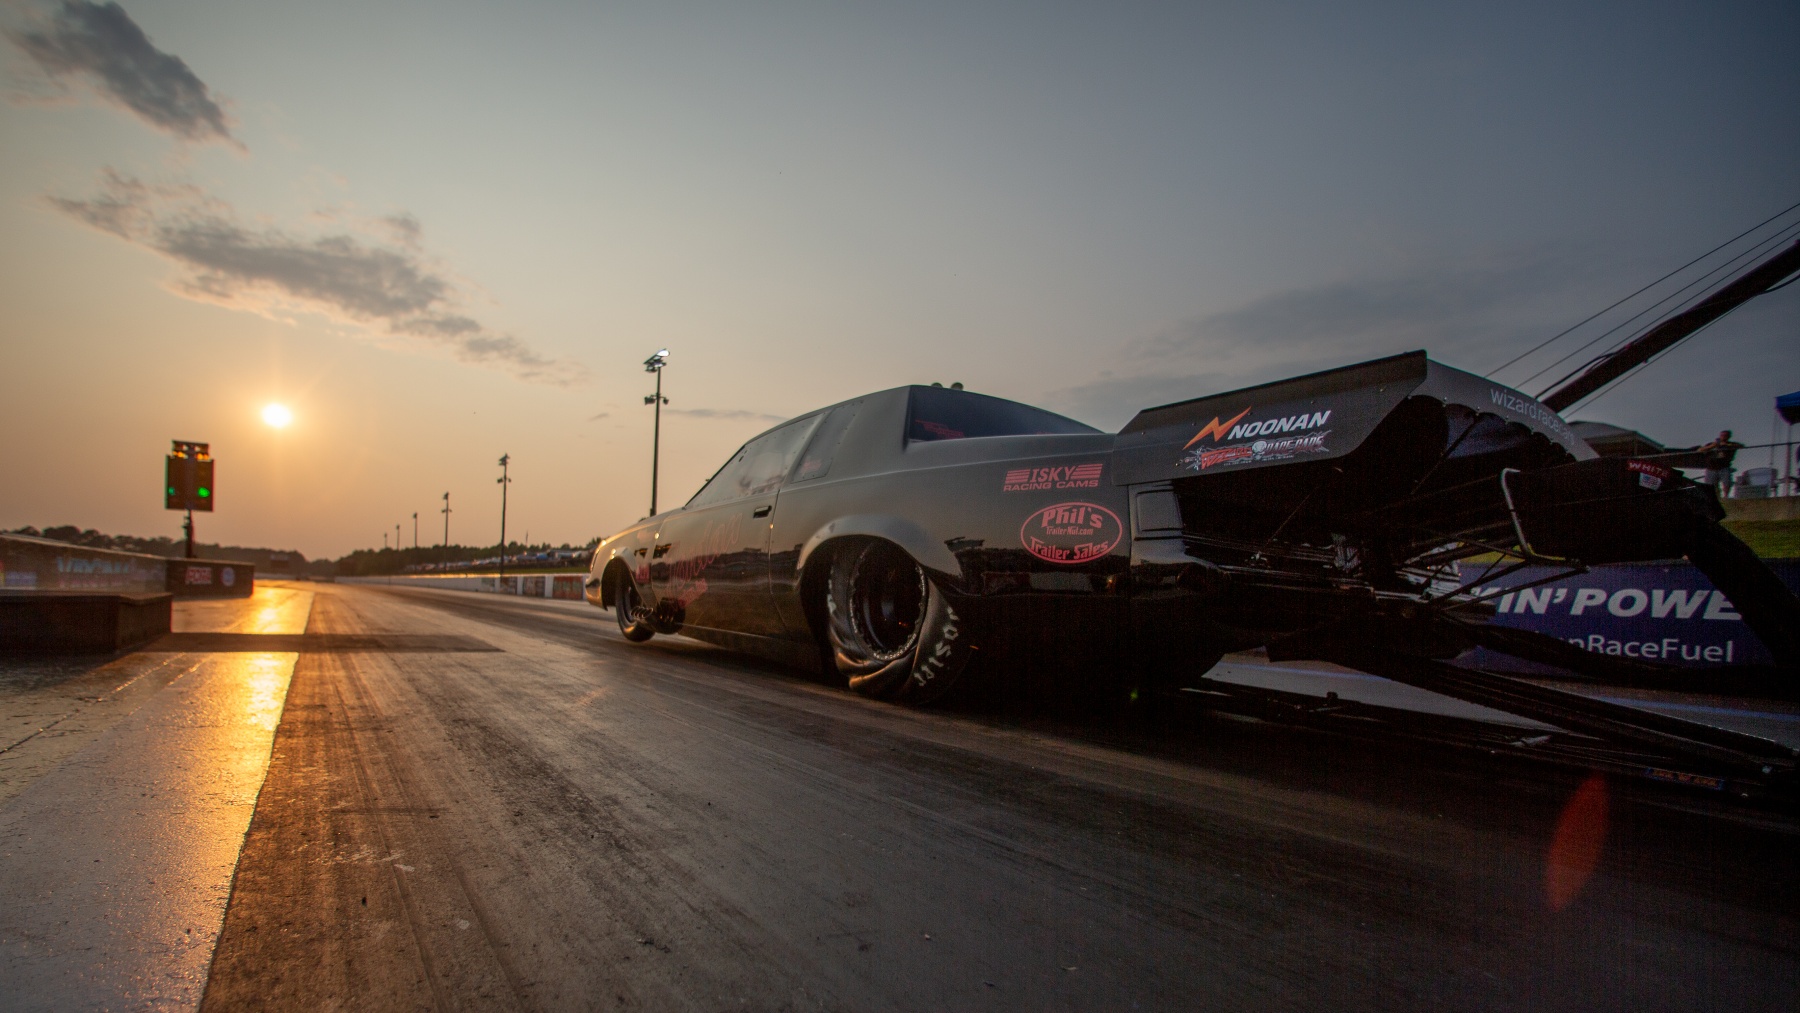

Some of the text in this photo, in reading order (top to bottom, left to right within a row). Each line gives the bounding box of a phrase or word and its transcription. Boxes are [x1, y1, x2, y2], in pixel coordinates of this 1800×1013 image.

[1227, 410, 1331, 440] NOONAN
[1030, 466, 1076, 482] ISKY
[1003, 480, 1098, 492] RACING CAMS
[1041, 506, 1103, 529] Phil's
[1030, 536, 1109, 560] Trailer Sales
[1557, 633, 1734, 663] nRaceFuel
